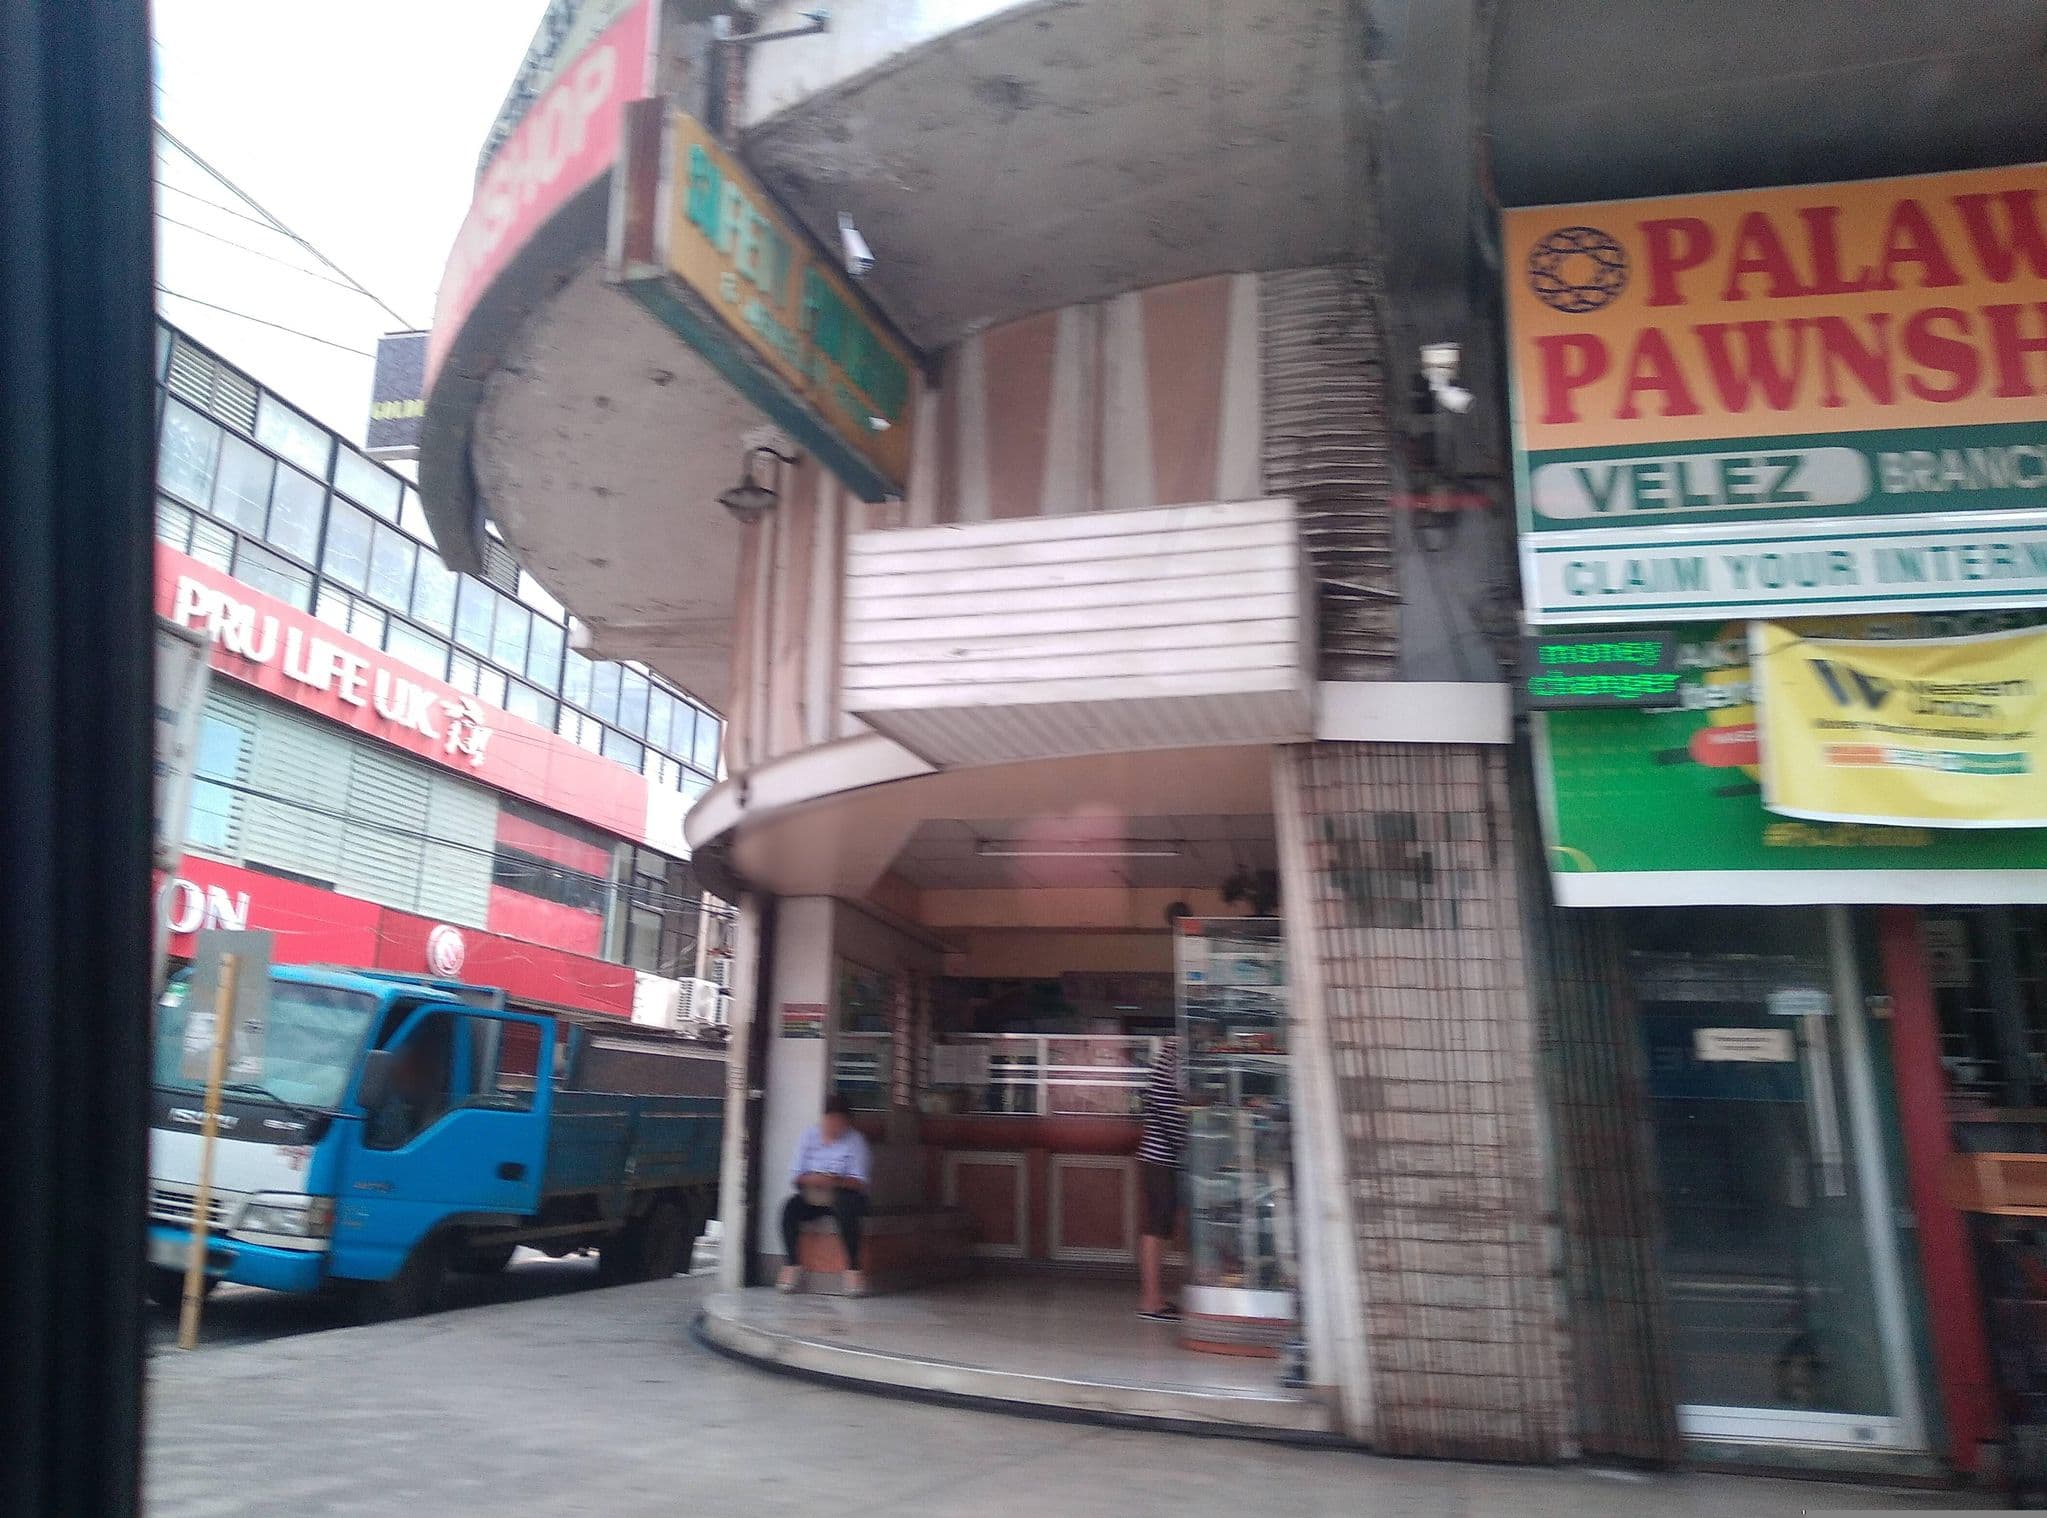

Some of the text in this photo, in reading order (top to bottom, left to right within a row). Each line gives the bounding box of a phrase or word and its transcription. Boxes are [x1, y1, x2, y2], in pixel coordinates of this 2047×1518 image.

[1639, 190, 2047, 306] PALAW
[1533, 304, 2047, 425] PAWNSH
[1573, 456, 1809, 513] VELEZ
[1568, 557, 1709, 596] CLAIM
[1724, 551, 1859, 591] YOUR
[175, 577, 439, 737] PRU LIFE UK
[1538, 640, 1663, 666] money
